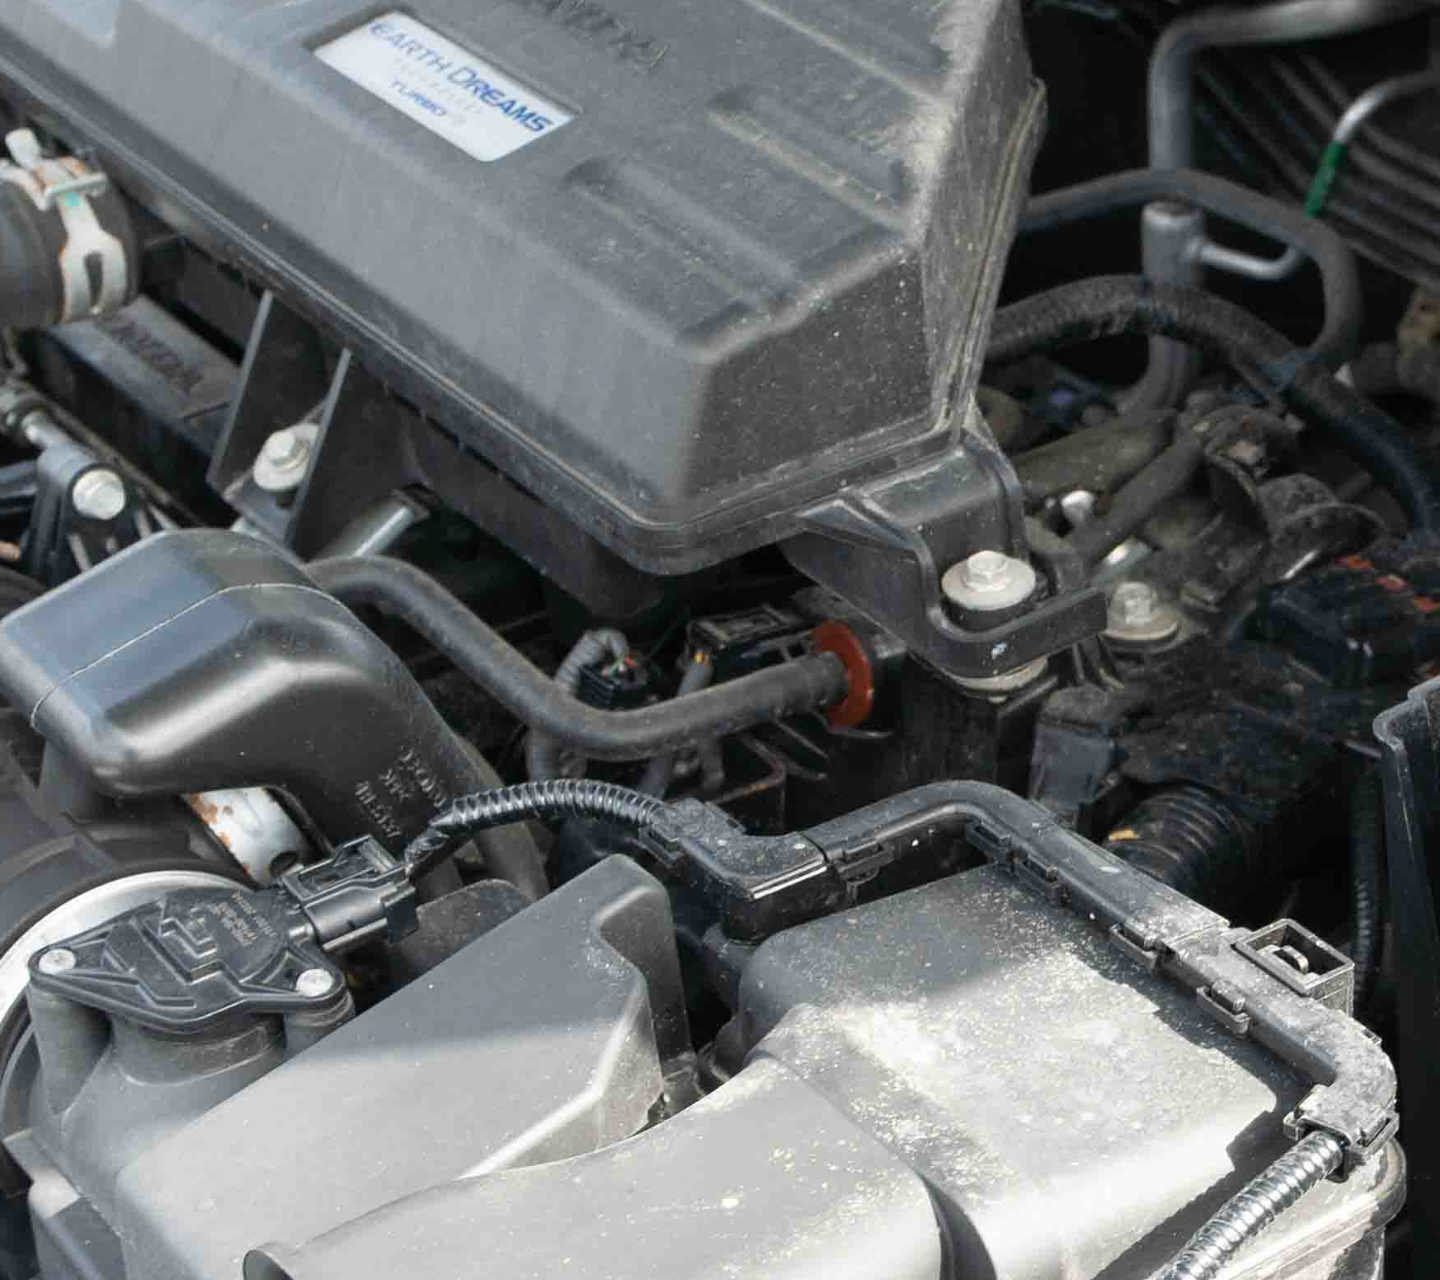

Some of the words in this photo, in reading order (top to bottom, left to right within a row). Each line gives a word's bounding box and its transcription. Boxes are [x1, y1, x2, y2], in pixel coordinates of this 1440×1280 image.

[369, 21, 448, 74] EARTH
[449, 66, 553, 134] DREAMS
[389, 78, 448, 118] TURBO
